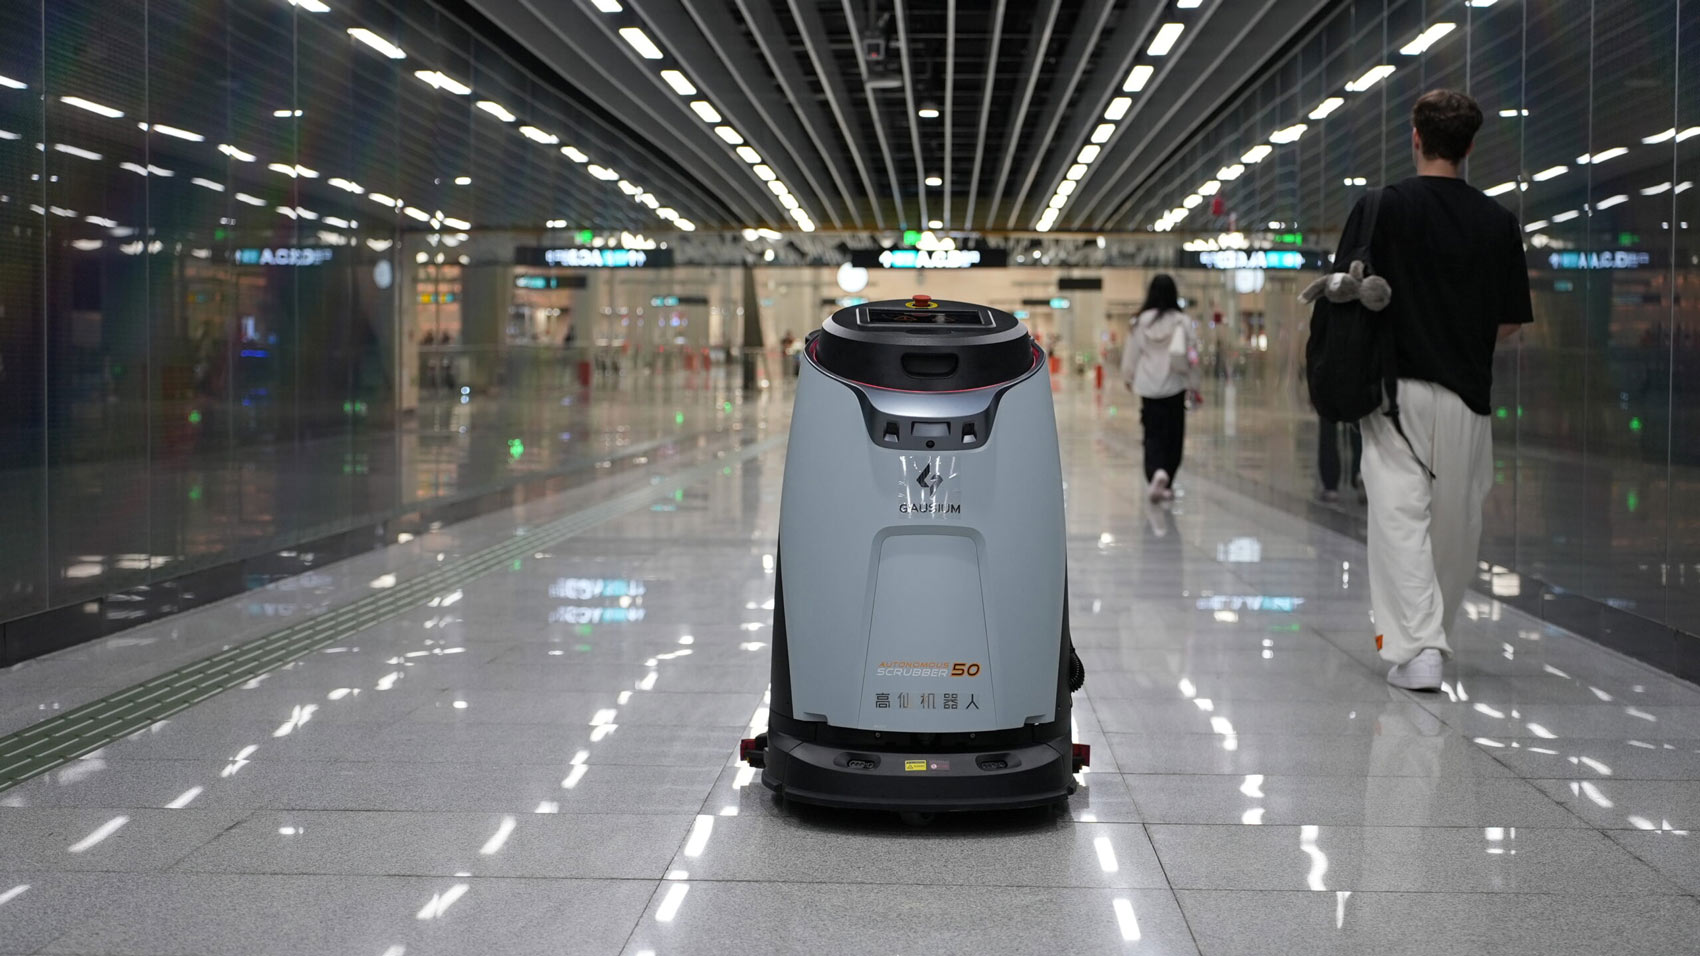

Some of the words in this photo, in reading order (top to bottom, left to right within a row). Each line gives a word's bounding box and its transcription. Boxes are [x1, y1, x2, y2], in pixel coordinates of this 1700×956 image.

[899, 503, 961, 514] GAUSIUM
[876, 667, 948, 677] SCRUBBER
[950, 663, 980, 677] 50
[875, 692, 979, 710] 高仙机器人
